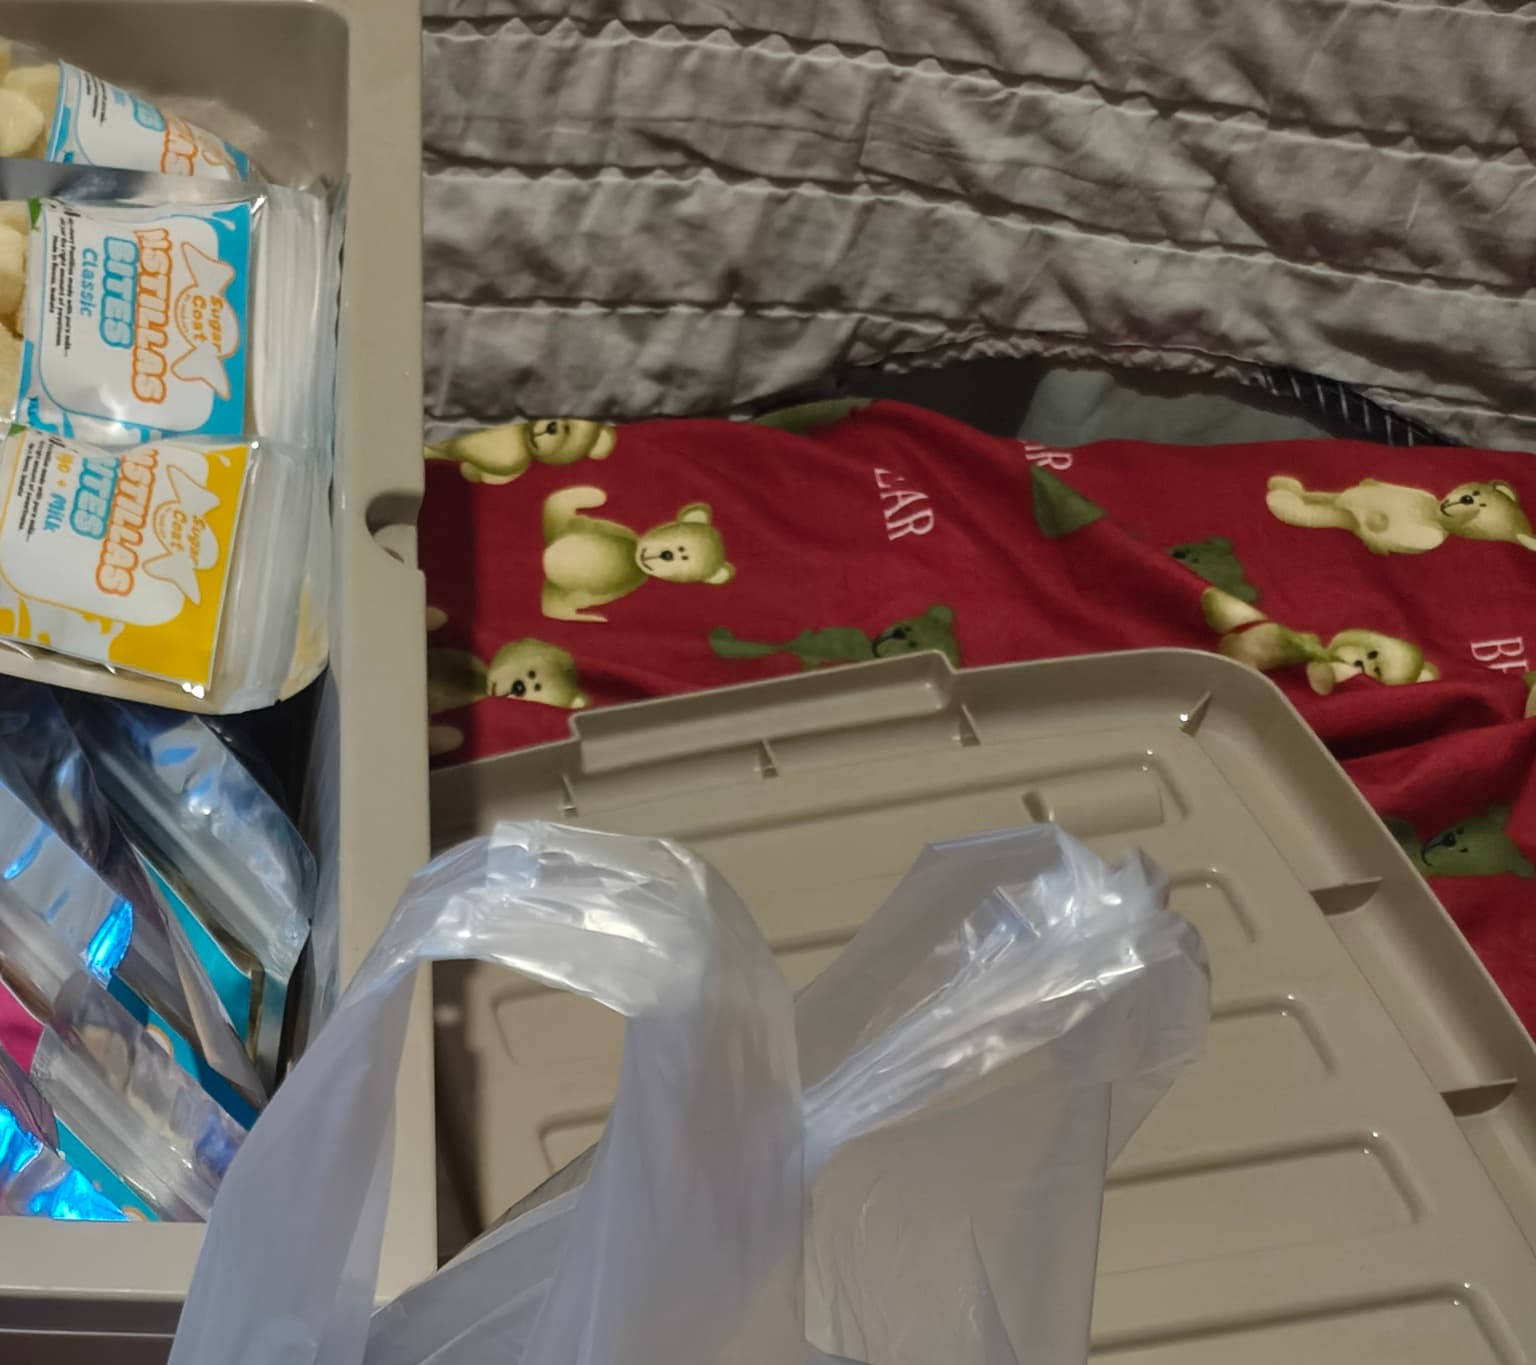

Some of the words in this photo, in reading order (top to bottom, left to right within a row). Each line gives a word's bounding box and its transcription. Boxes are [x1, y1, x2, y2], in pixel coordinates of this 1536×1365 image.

[80, 247, 98, 318] Classic
[99, 236, 139, 349] BITES
[208, 295, 223, 353] Sugar
[44, 493, 66, 533] Milk
[188, 514, 205, 565] Sugar
